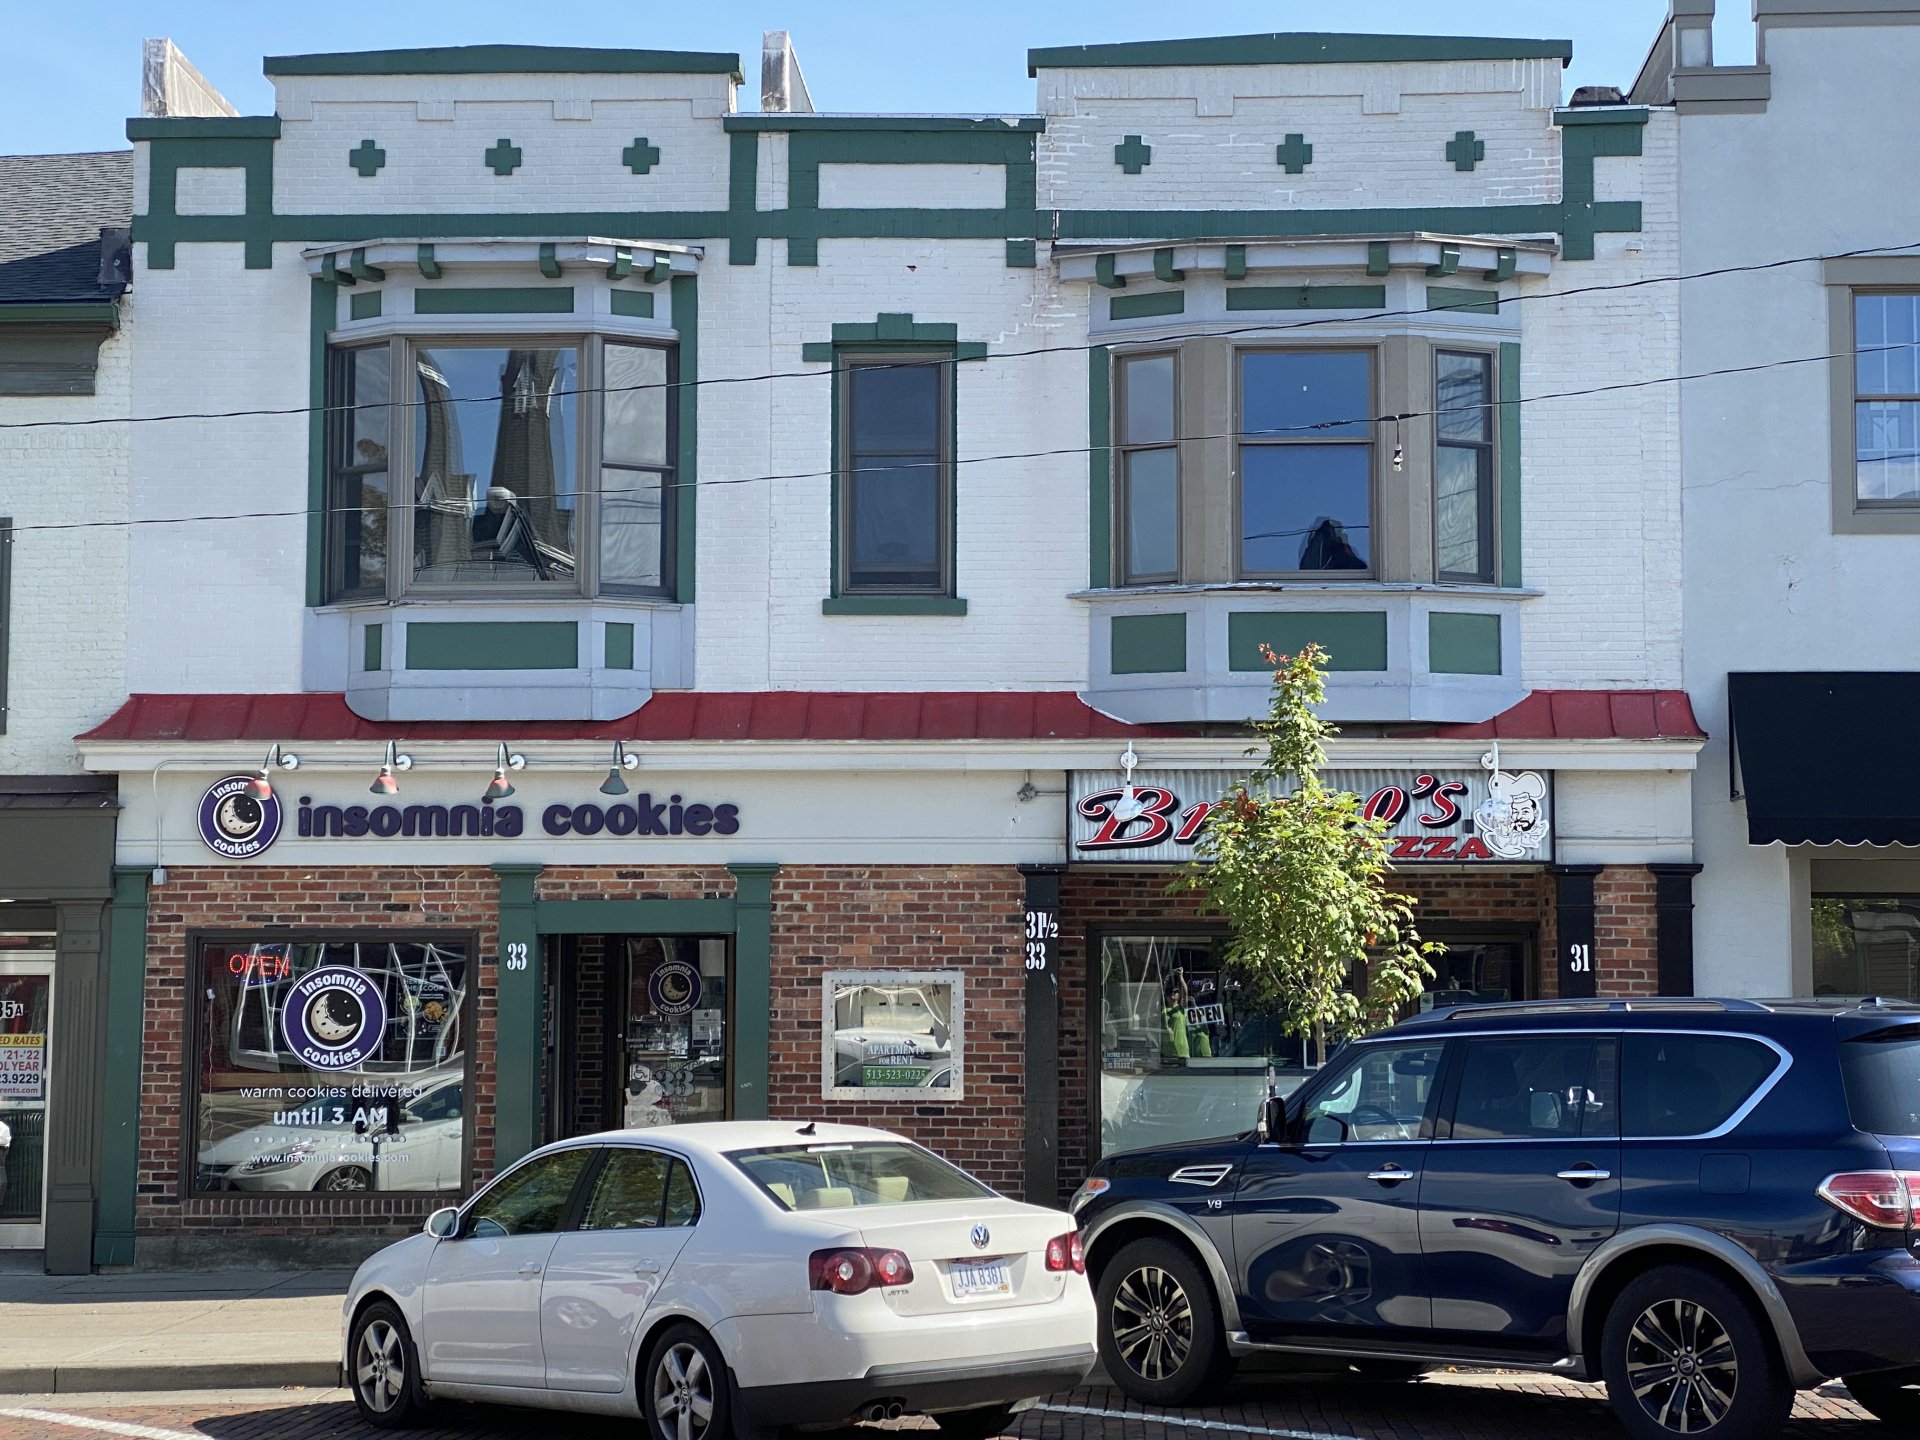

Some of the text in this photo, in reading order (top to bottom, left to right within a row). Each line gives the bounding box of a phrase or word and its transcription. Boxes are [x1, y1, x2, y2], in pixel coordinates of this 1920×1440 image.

[298, 793, 740, 838] insomnia cookies
[1077, 775, 1469, 851] Bro's
[213, 839, 260, 855] cookies
[506, 943, 528, 971] 33
[1025, 942, 1046, 970] 33
[1571, 944, 1590, 972] 31
[229, 954, 290, 976] OPEN
[656, 965, 692, 977] insomnia
[299, 974, 367, 997] insomnia
[660, 1003, 691, 1013] cookies
[1187, 1005, 1221, 1025] OPEN
[13, 1036, 41, 1045] RATES
[303, 1048, 361, 1065] cookies
[867, 1045, 926, 1055] APARTMENTS
[12, 1062, 39, 1072] YEAR
[890, 1055, 915, 1065] RENT
[0, 1073, 39, 1084] 3.9229
[866, 1069, 926, 1080] 513-523-0225
[239, 1085, 423, 1098] warm cookies delivered
[273, 1107, 388, 1125] until 3 AM
[1208, 1199, 1222, 1209] V8
[958, 1266, 1005, 1288] JJA 8381
